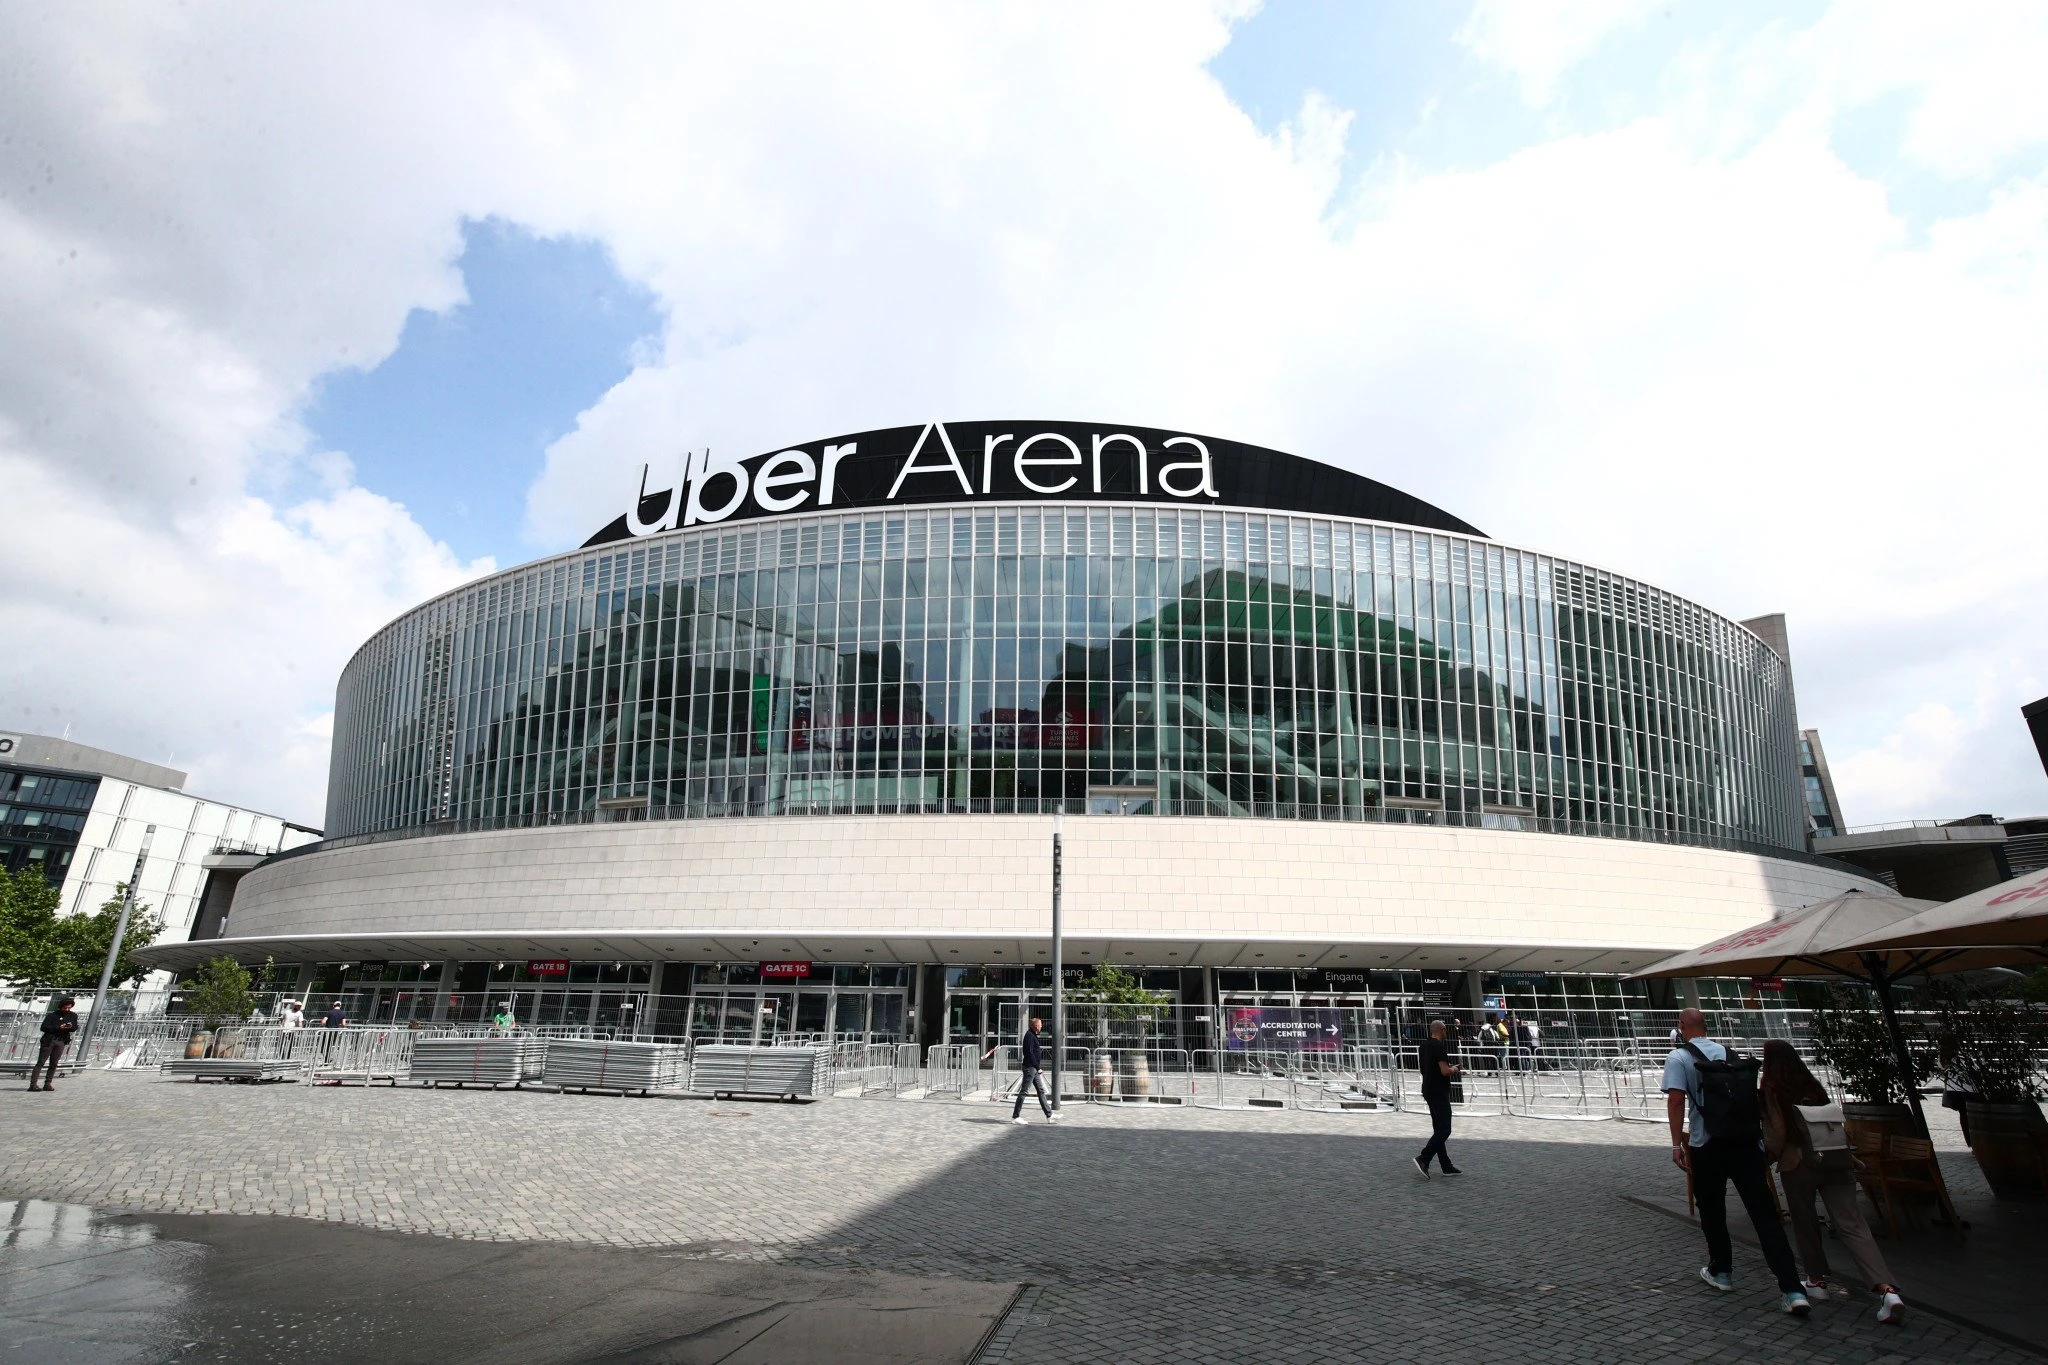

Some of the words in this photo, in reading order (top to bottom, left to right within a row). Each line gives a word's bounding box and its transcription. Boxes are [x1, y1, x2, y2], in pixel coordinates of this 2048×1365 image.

[625, 441, 858, 537] Uber
[886, 416, 1220, 499] Arena
[845, 726, 911, 742] HOME
[915, 725, 944, 739] OF
[362, 963, 384, 973] Eingang
[532, 963, 555, 971] GATE
[556, 963, 566, 971] 1B
[765, 964, 793, 972] GATE
[795, 964, 807, 972] 1C
[1042, 967, 1084, 979] Eigang
[1325, 971, 1364, 983] Eingang
[1261, 1022, 1322, 1030] ACCREDITATION
[1276, 1030, 1307, 1038] CENTRE
